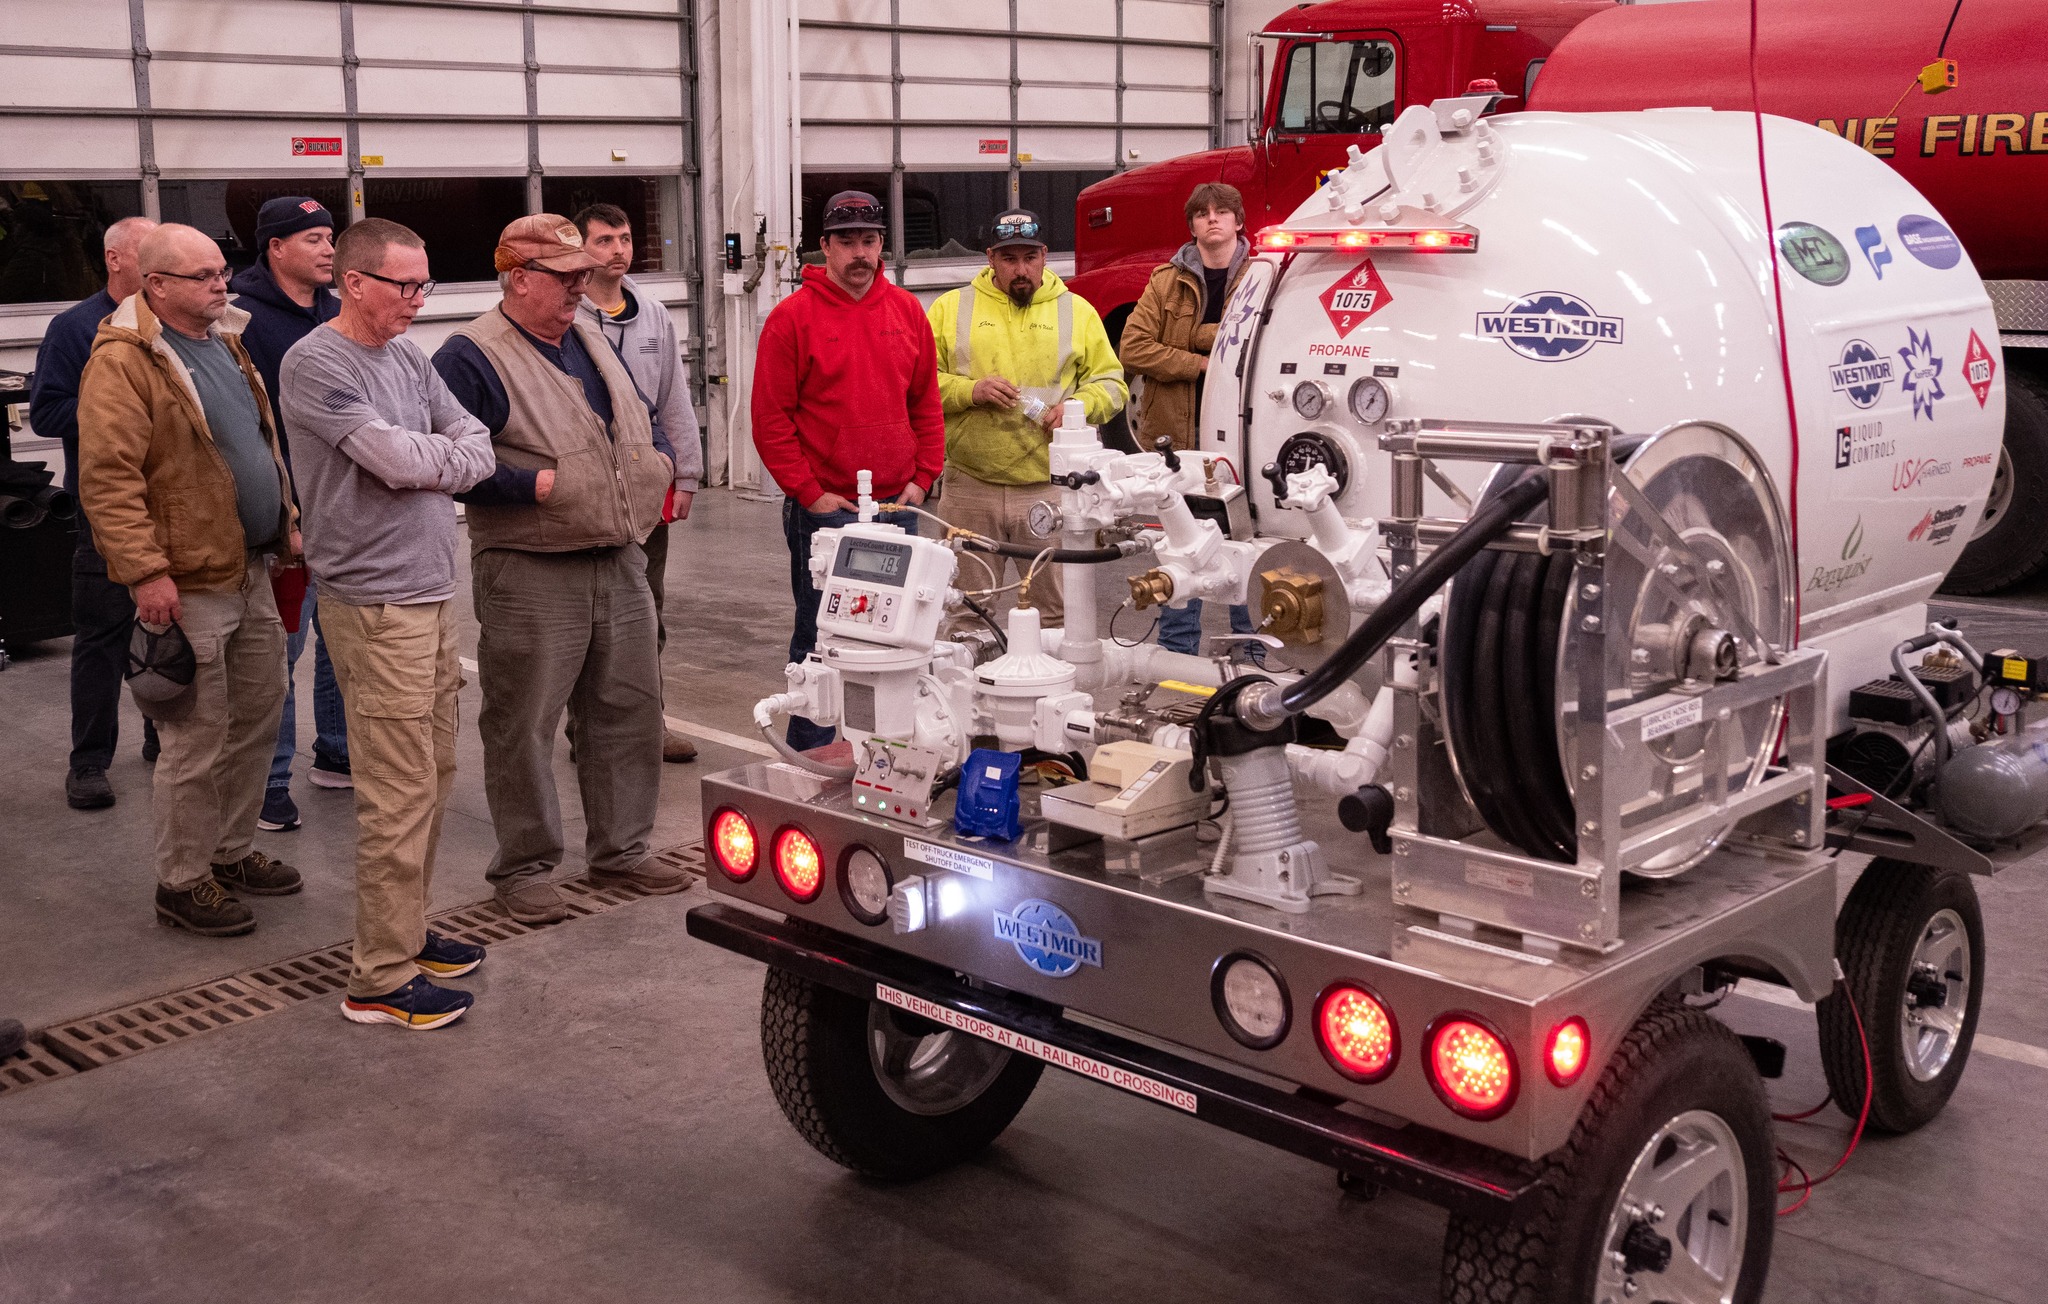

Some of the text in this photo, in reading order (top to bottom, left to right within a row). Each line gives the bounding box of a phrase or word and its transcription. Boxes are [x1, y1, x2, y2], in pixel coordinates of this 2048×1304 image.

[355, 193, 362, 205] 4
[1336, 292, 1373, 309] 1075
[1341, 315, 1351, 328] 2
[1483, 317, 1618, 339] WESTMOR
[1308, 344, 1371, 358] PROPANE
[1832, 362, 1892, 386] WESTMOR
[1970, 362, 1989, 382] 1075
[1853, 421, 1883, 442] LIQUID
[1852, 440, 1896, 464] CONTROLS
[1963, 453, 1992, 468] PROPANE
[905, 839, 992, 870] TEST OFF-TRUCK EMERGENCY
[925, 855, 972, 874] SHUTOFF DAILY
[998, 917, 1098, 962] WESTMOR
[878, 985, 1196, 1111] THIS VEHICLE STOPS AT ALL RAILROAD CROSSINGS
